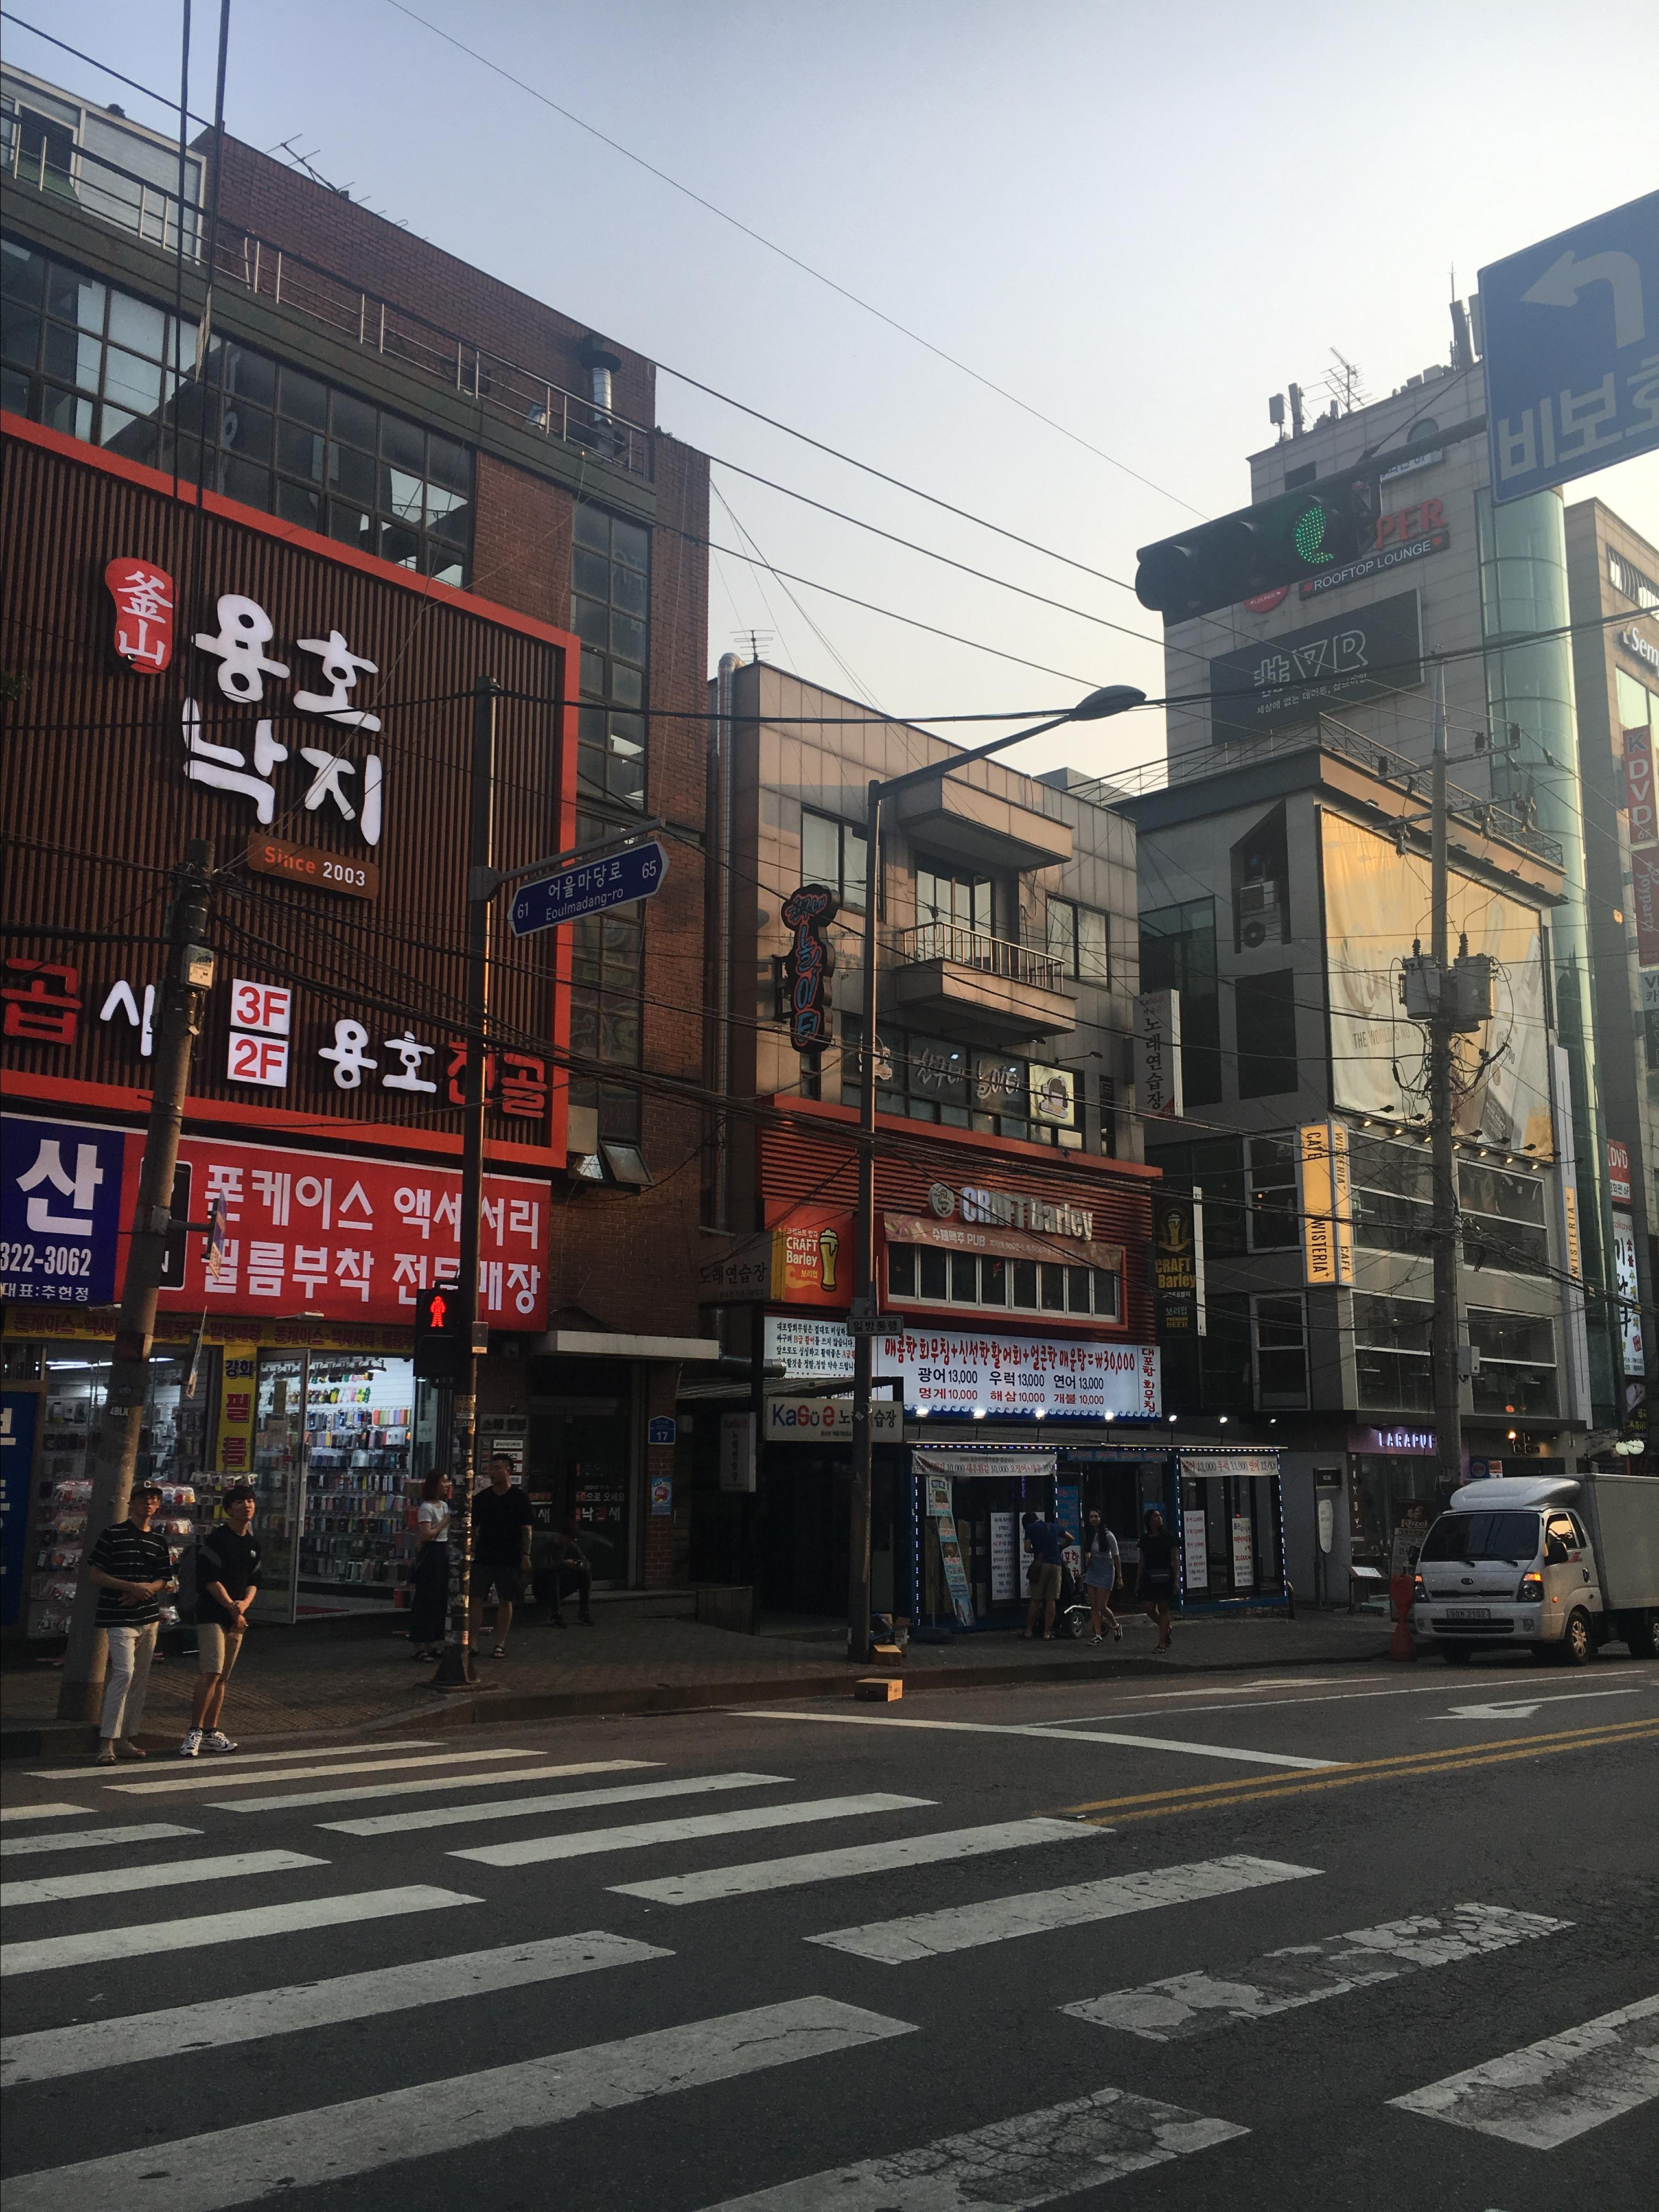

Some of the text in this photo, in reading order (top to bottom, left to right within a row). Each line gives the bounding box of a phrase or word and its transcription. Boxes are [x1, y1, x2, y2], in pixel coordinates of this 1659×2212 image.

[1314, 540, 1431, 591] ROOFTOP LOUNGE
[117, 569, 174, 666] 釜山
[191, 593, 380, 732] 용호
[1257, 700, 1281, 714] 세상에
[1284, 695, 1300, 708] 없는
[181, 697, 382, 846] 낙지
[264, 845, 365, 887] Since 2003
[642, 859, 657, 879] 65
[548, 861, 623, 901] 어울마당로
[517, 902, 529, 920] 61
[546, 888, 624, 922] Eoulmadang-ro
[237, 984, 288, 1029] 3F
[1352, 1031, 1368, 1049] THE
[233, 1038, 286, 1080] 2F
[1143, 1018, 1165, 1110] 노래연습장
[1306, 1132, 1323, 1159] CAFE
[16, 1139, 104, 1237] 산
[204, 1164, 374, 1231] 폰케이스
[959, 1186, 1094, 1242] CRAFT Barley
[786, 1236, 818, 1252] CRAFT
[932, 1228, 965, 1244] 수제맥주
[967, 1234, 986, 1247] PUB
[786, 1250, 818, 1268] Barley
[1155, 1257, 1192, 1274] CRAFT
[1340, 1245, 1351, 1273] CAFE
[202, 1237, 375, 1303] 필름부착
[699, 1261, 767, 1285] 노래연습장
[800, 1269, 818, 1279] 보리펍
[1158, 1273, 1196, 1289] Barley
[1165, 1305, 1188, 1316] 보리펍
[814, 1325, 830, 1335] 절대로
[853, 1319, 898, 1333] 일방통행
[776, 1345, 798, 1356] 앞으로도
[793, 1335, 804, 1344] B급
[821, 1338, 831, 1347] 쓰지
[885, 1334, 918, 1364] 매콤한
[225, 1359, 254, 1379] 강화
[828, 1362, 838, 1371] 약속
[839, 1362, 855, 1371] 드립니
[918, 1367, 1104, 1391] 광어 13,000 우럭 13,000 연어 13,000
[1141, 1347, 1156, 1413] 대포항 회무침
[919, 1387, 1104, 1405] 멍게 10,000 해삼 10,000 개불 10,000
[839, 1408, 898, 1428] 노습장
[656, 1431, 669, 1442] 17
[947, 1464, 965, 1473] 10,000
[991, 1464, 1009, 1473] 10,000
[1197, 1461, 1216, 1473] 13,000
[1218, 1460, 1230, 1472] 우럭
[1231, 1461, 1248, 1471] 13,000
[144, 1480, 152, 1489] C
[603, 1492, 625, 1502] 오세요
[1467, 1610, 1485, 1618] 2102
